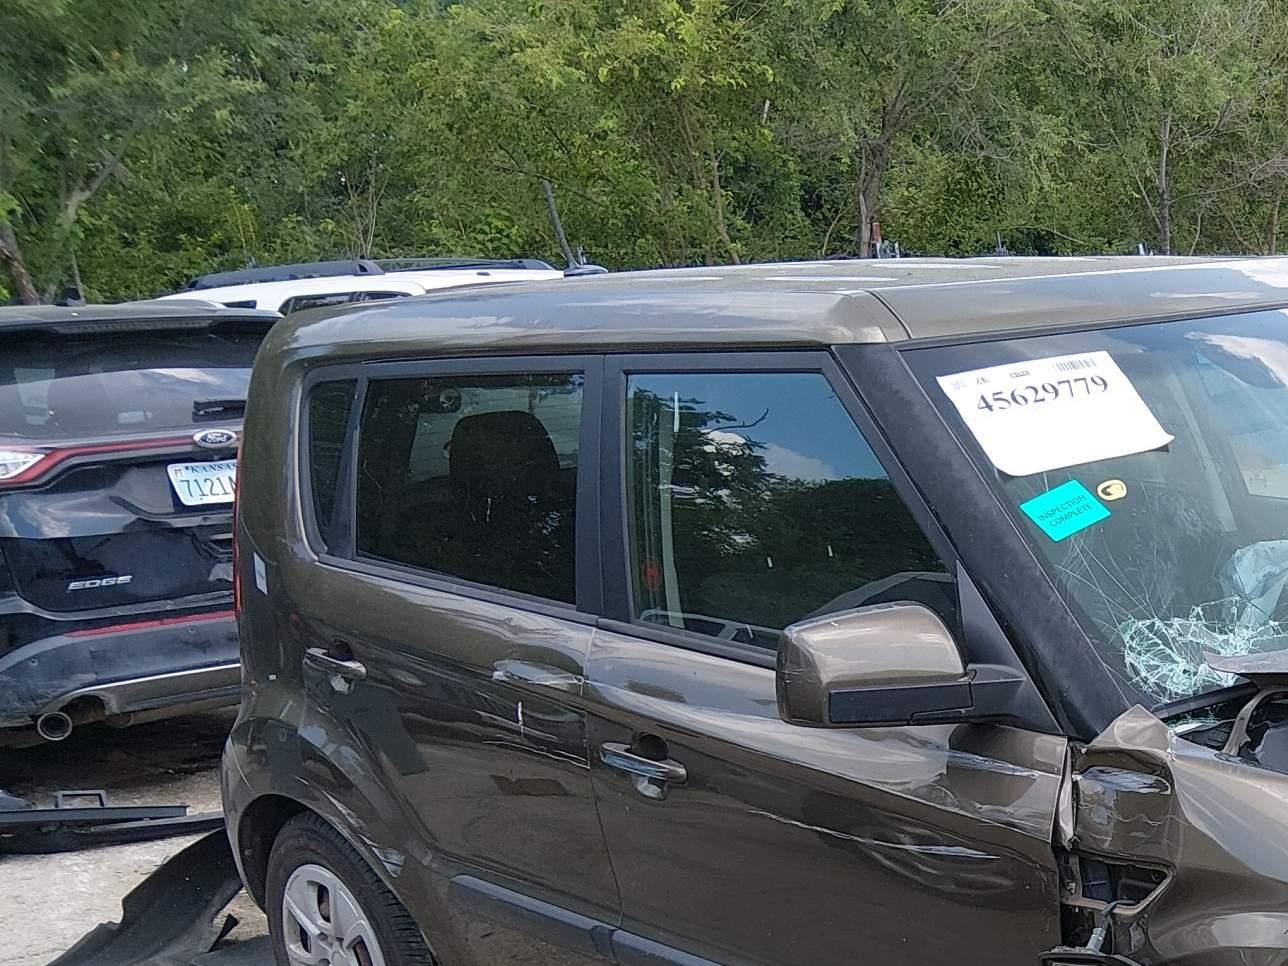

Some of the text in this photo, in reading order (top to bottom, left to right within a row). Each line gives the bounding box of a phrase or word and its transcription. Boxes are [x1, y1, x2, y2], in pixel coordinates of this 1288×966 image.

[977, 375, 1108, 412] 45629779
[1037, 494, 1087, 521] INSPECTION
[1049, 502, 1094, 527] COMPLETE
[67, 575, 133, 590] EDGE
